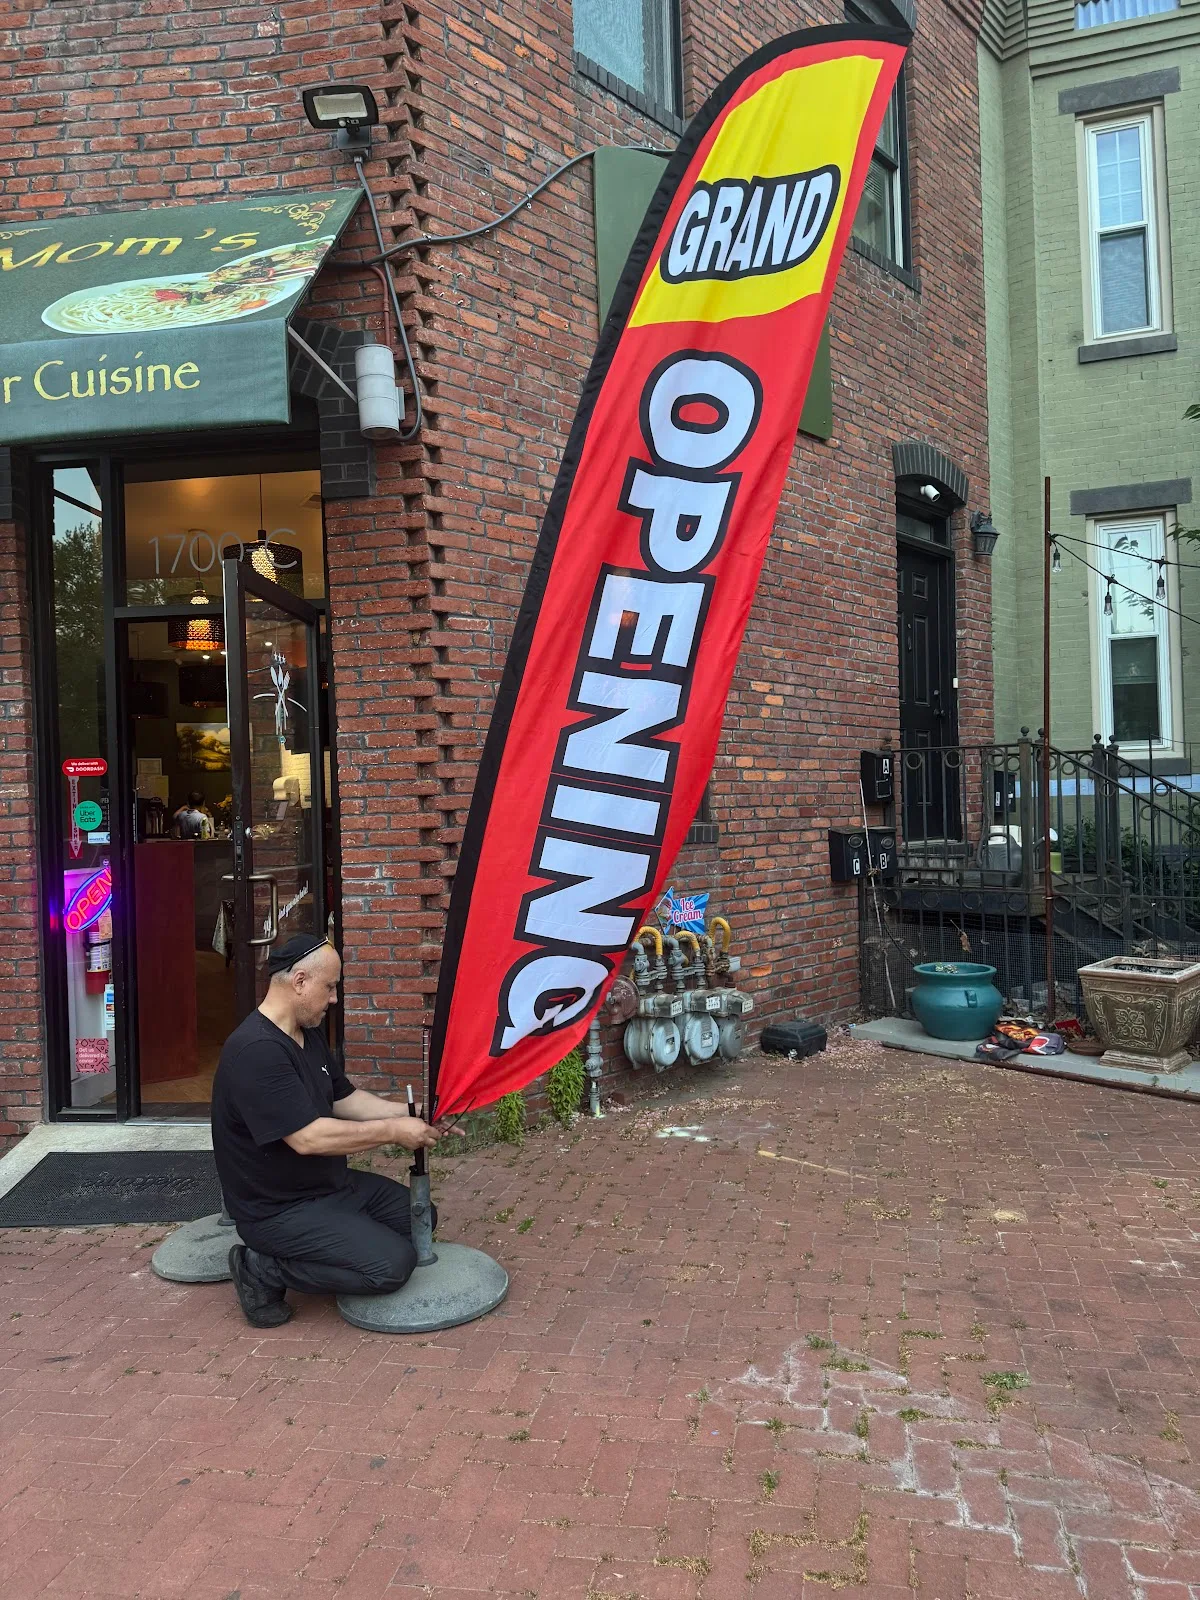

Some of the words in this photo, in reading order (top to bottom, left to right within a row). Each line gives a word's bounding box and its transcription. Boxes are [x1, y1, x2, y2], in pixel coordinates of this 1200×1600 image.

[667, 171, 833, 277] GRAND
[148, 528, 298, 574] 1700-C
[500, 356, 757, 1051] OPENING
[67, 868, 112, 930] OPEN
[673, 910, 703, 924] Cream
[680, 898, 695, 911] Ice
